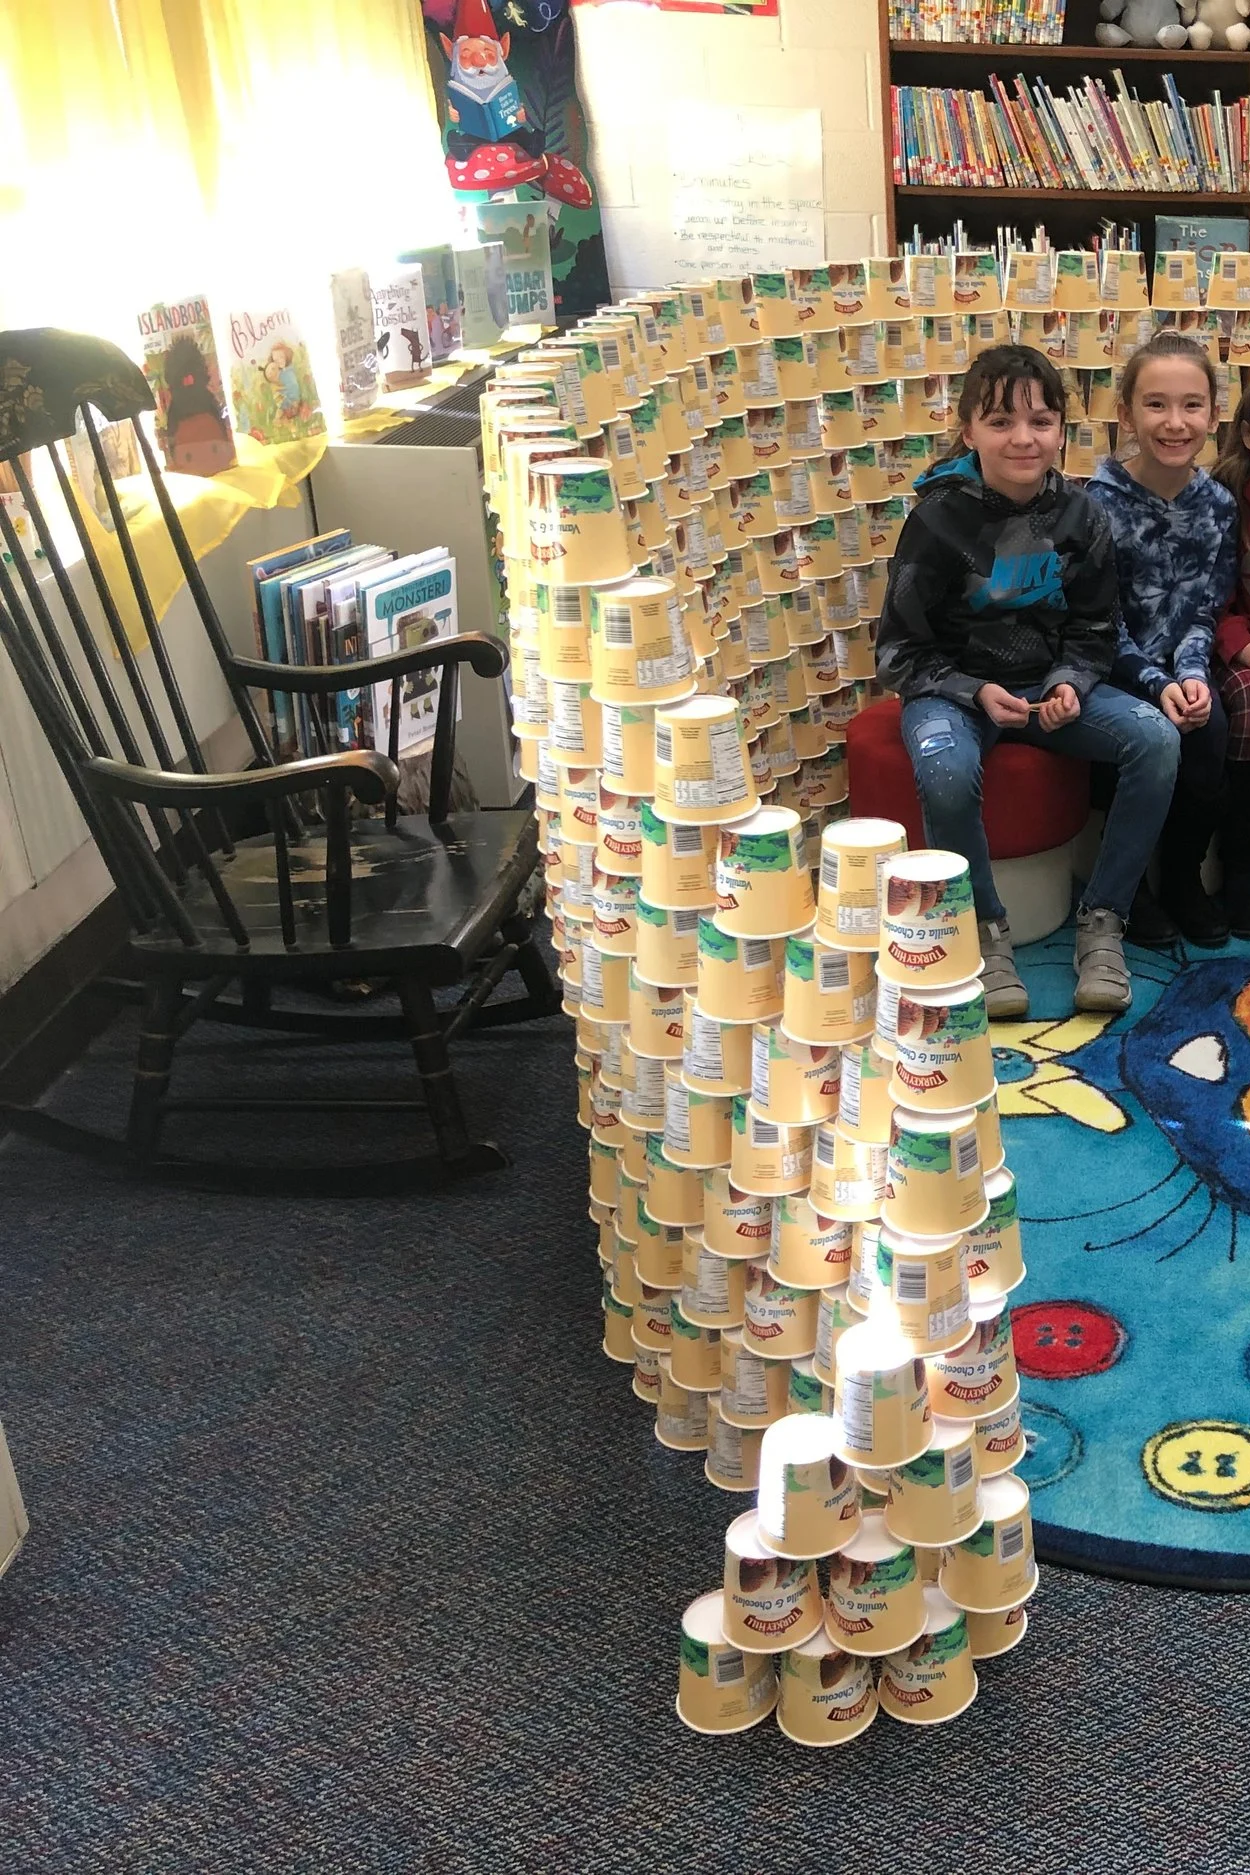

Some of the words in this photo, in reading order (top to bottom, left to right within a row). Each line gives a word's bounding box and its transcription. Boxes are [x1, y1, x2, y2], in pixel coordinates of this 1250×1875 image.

[1179, 225, 1208, 238] The
[506, 271, 546, 292] ABARI
[509, 291, 549, 315] UMPS
[376, 307, 418, 326] Possible
[229, 308, 291, 358] Bloom
[991, 551, 1063, 591] NIKE
[382, 580, 446, 616] MONSTER!
[606, 837, 622, 852] HILL
[930, 926, 960, 940] Vanilla
[892, 944, 906, 962] HILL
[907, 950, 944, 964] TURKEY
[931, 1053, 962, 1066] Vanilla
[910, 1070, 945, 1087] TURKEY
[723, 1208, 761, 1216] Chocolate
[741, 1226, 757, 1236] HILL
[973, 1241, 1002, 1253] Vanilla
[829, 1251, 844, 1262] HILL
[767, 1309, 796, 1319] Vanilla
[950, 1384, 967, 1398] HILL
[967, 1376, 1001, 1398] TURKEY
[989, 1438, 1005, 1450] HILL
[732, 1593, 773, 1610] Chocolate
[857, 1602, 888, 1612] Vanilla
[748, 1617, 766, 1632] HILL
[766, 1611, 800, 1630] TURKEY
[812, 1688, 854, 1703] Chocolate
[833, 1707, 849, 1720] HILL
